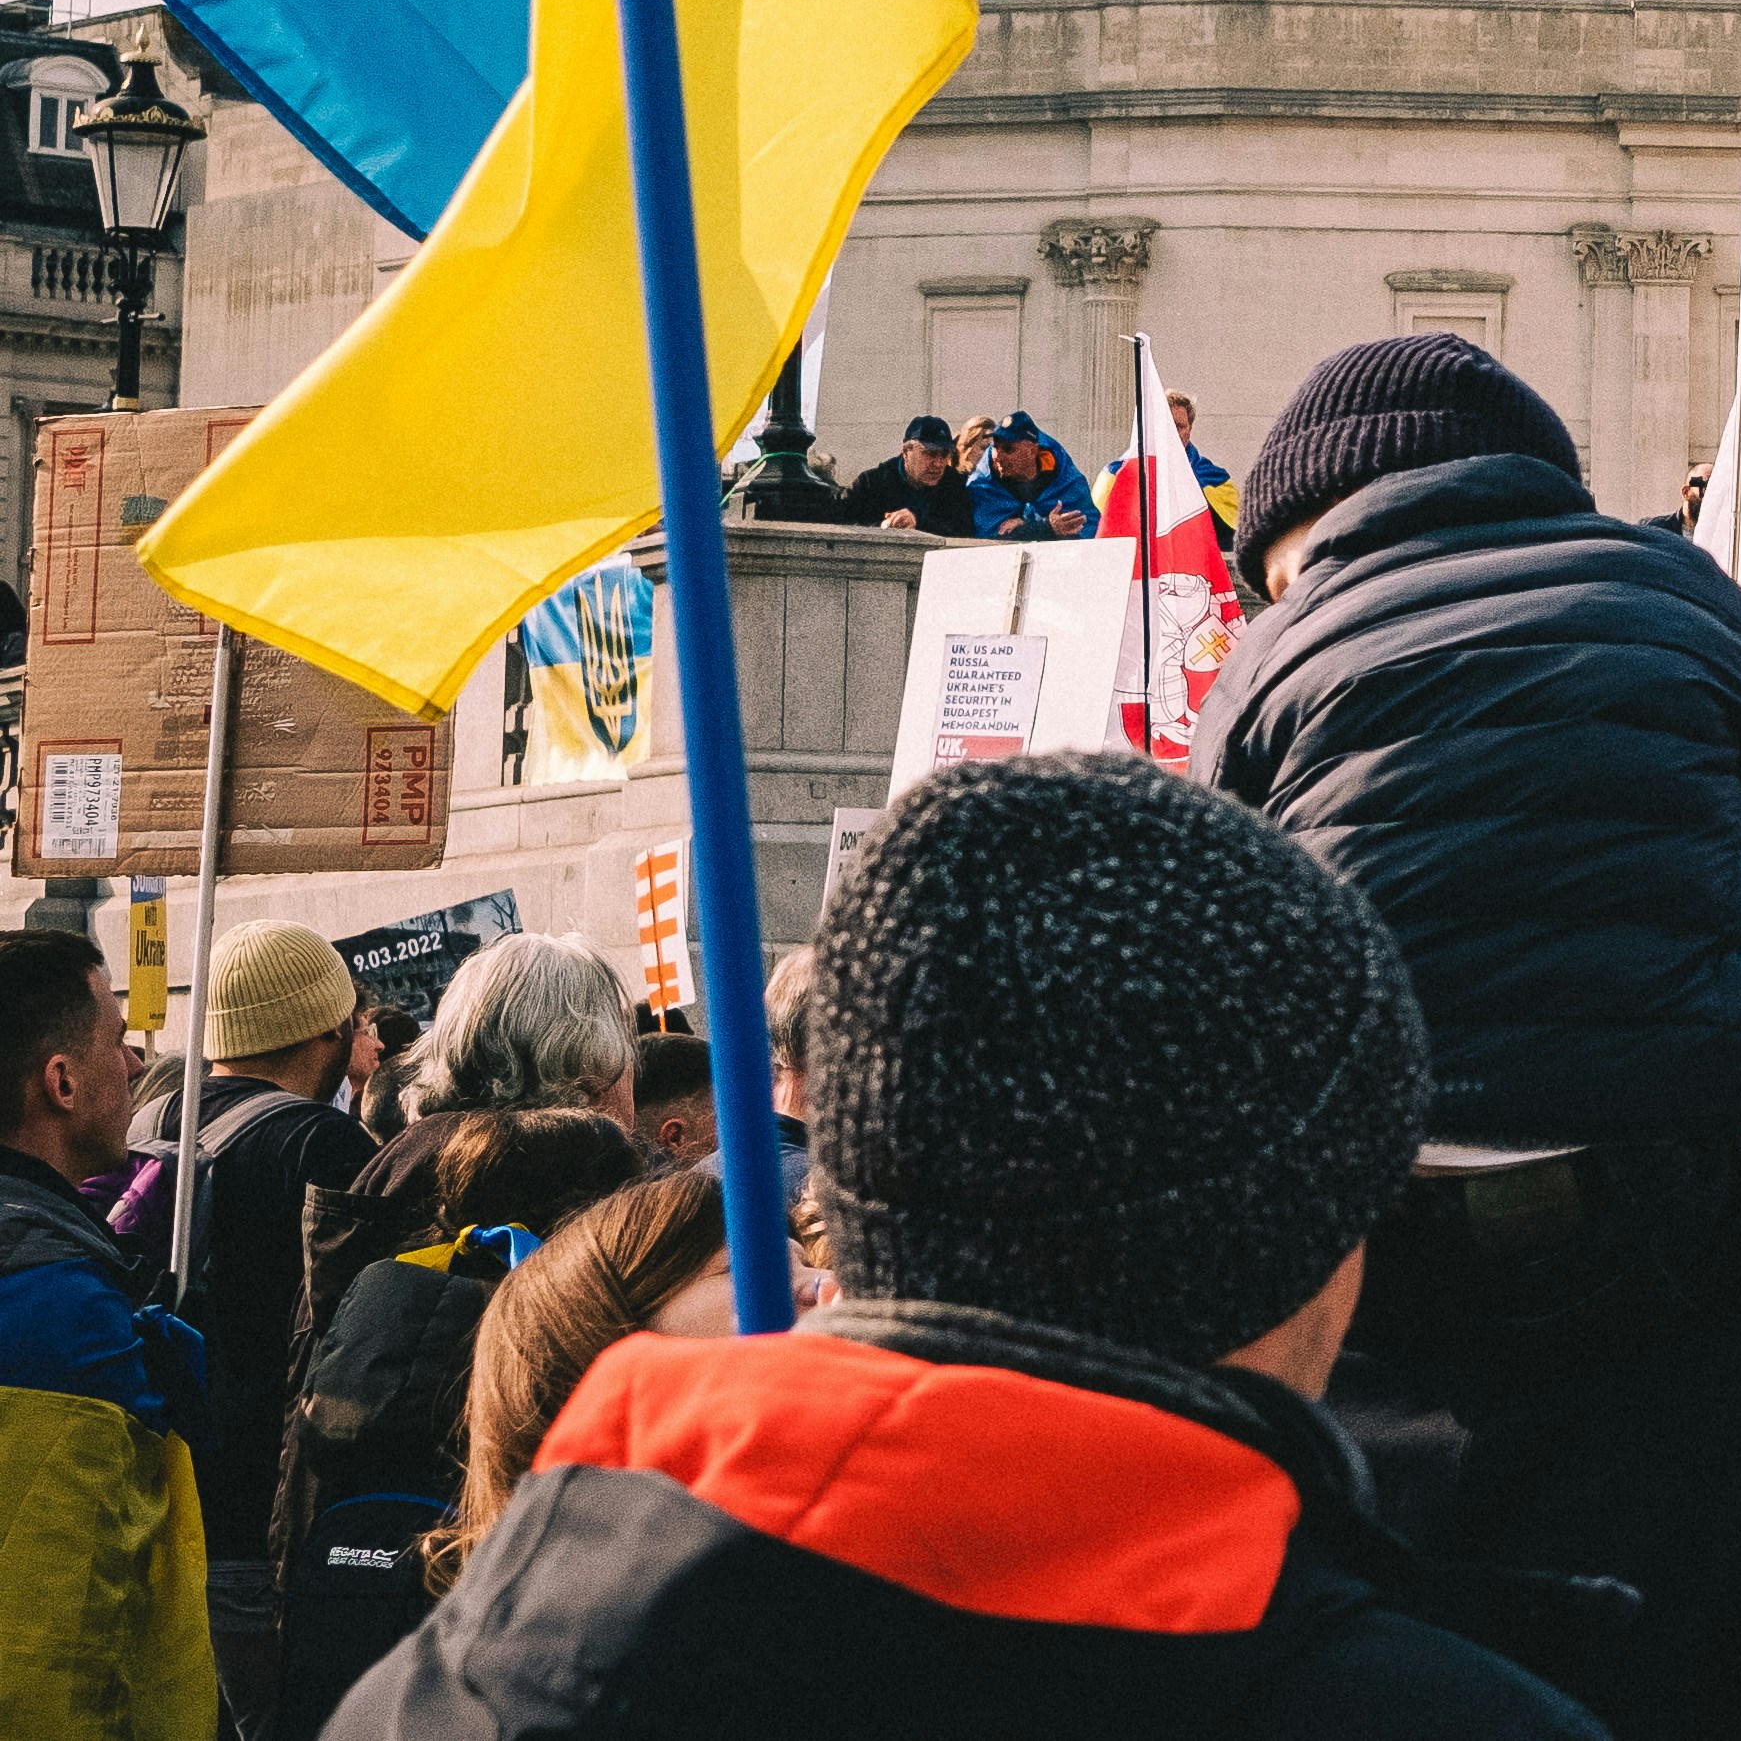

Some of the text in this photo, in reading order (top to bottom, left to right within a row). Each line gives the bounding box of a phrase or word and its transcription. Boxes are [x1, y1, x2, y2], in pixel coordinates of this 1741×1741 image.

[951, 644, 1014, 656] UK, US AND
[949, 657, 990, 667] RUSSIA
[948, 669, 1022, 681] GUARANTEED
[946, 682, 1005, 693] UKRAINE'S
[944, 695, 1012, 706] SECURITY IN
[943, 707, 999, 718] BUDAPEST
[941, 720, 1020, 731] MEMORANDUM
[937, 737, 969, 759] UK,
[371, 748, 393, 824] 973404
[400, 745, 428, 826] PMP
[84, 758, 102, 826] PMP973404
[329, 1546, 371, 1559] REGATTA
